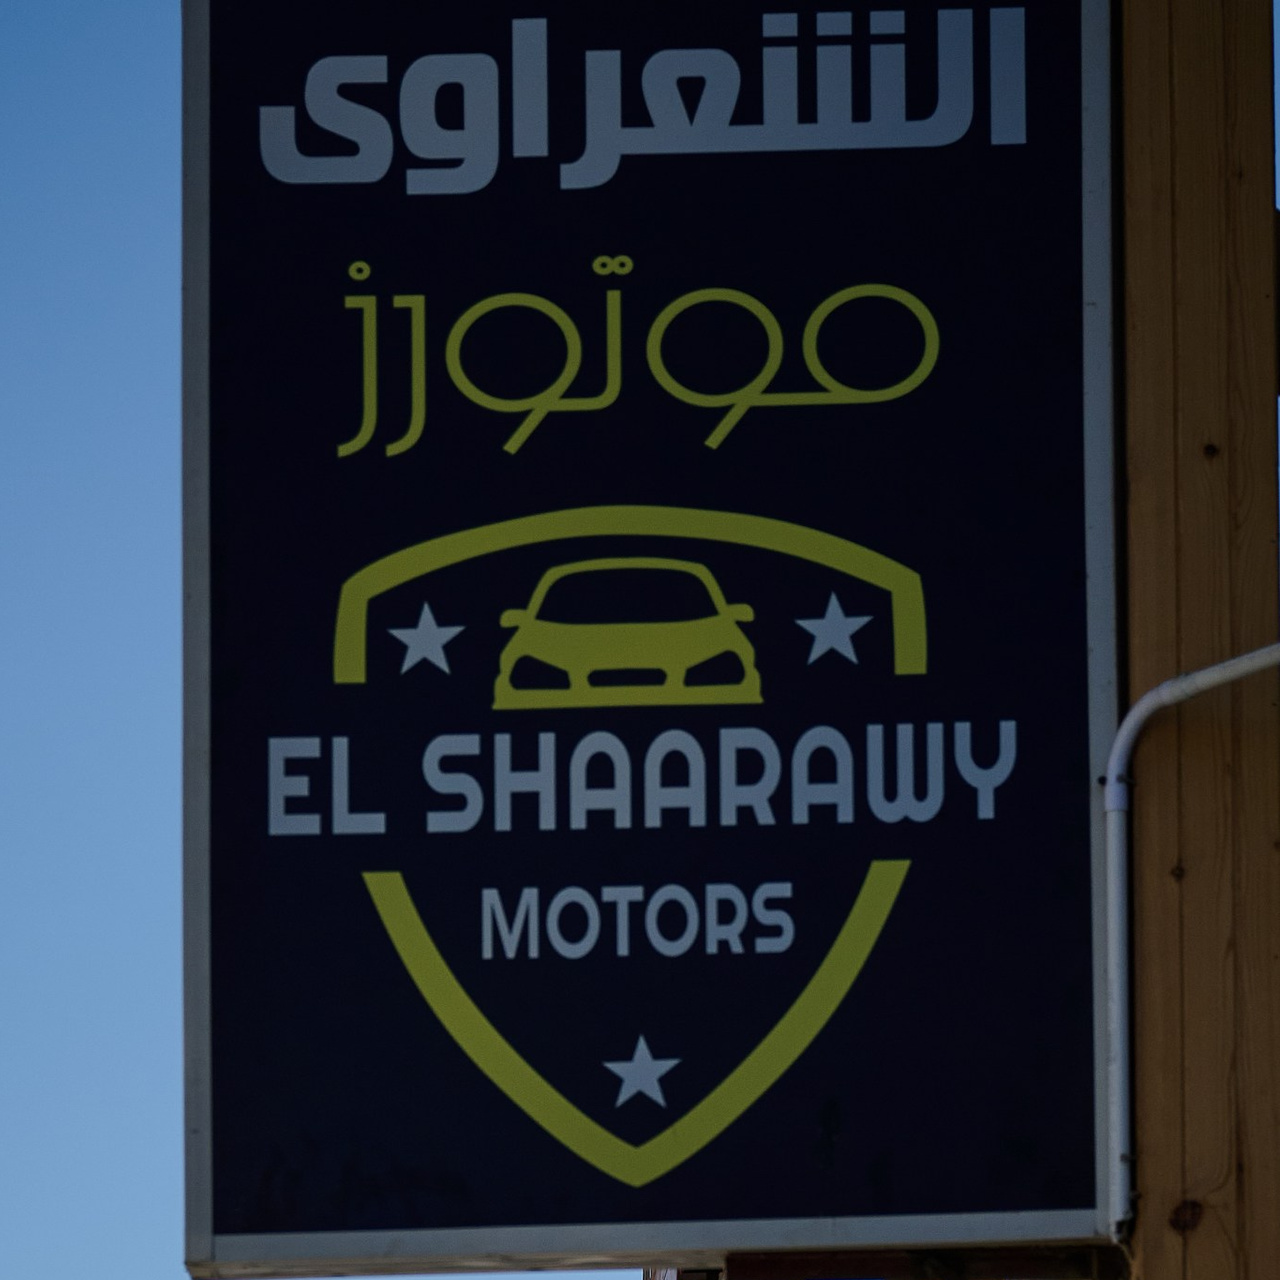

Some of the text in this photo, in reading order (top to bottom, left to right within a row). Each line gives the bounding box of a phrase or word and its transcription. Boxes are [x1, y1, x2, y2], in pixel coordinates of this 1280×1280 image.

[336, 254, 941, 459] موتورز
[267, 719, 1018, 837] EL SHAARAWY
[480, 881, 796, 961] MOTORS
